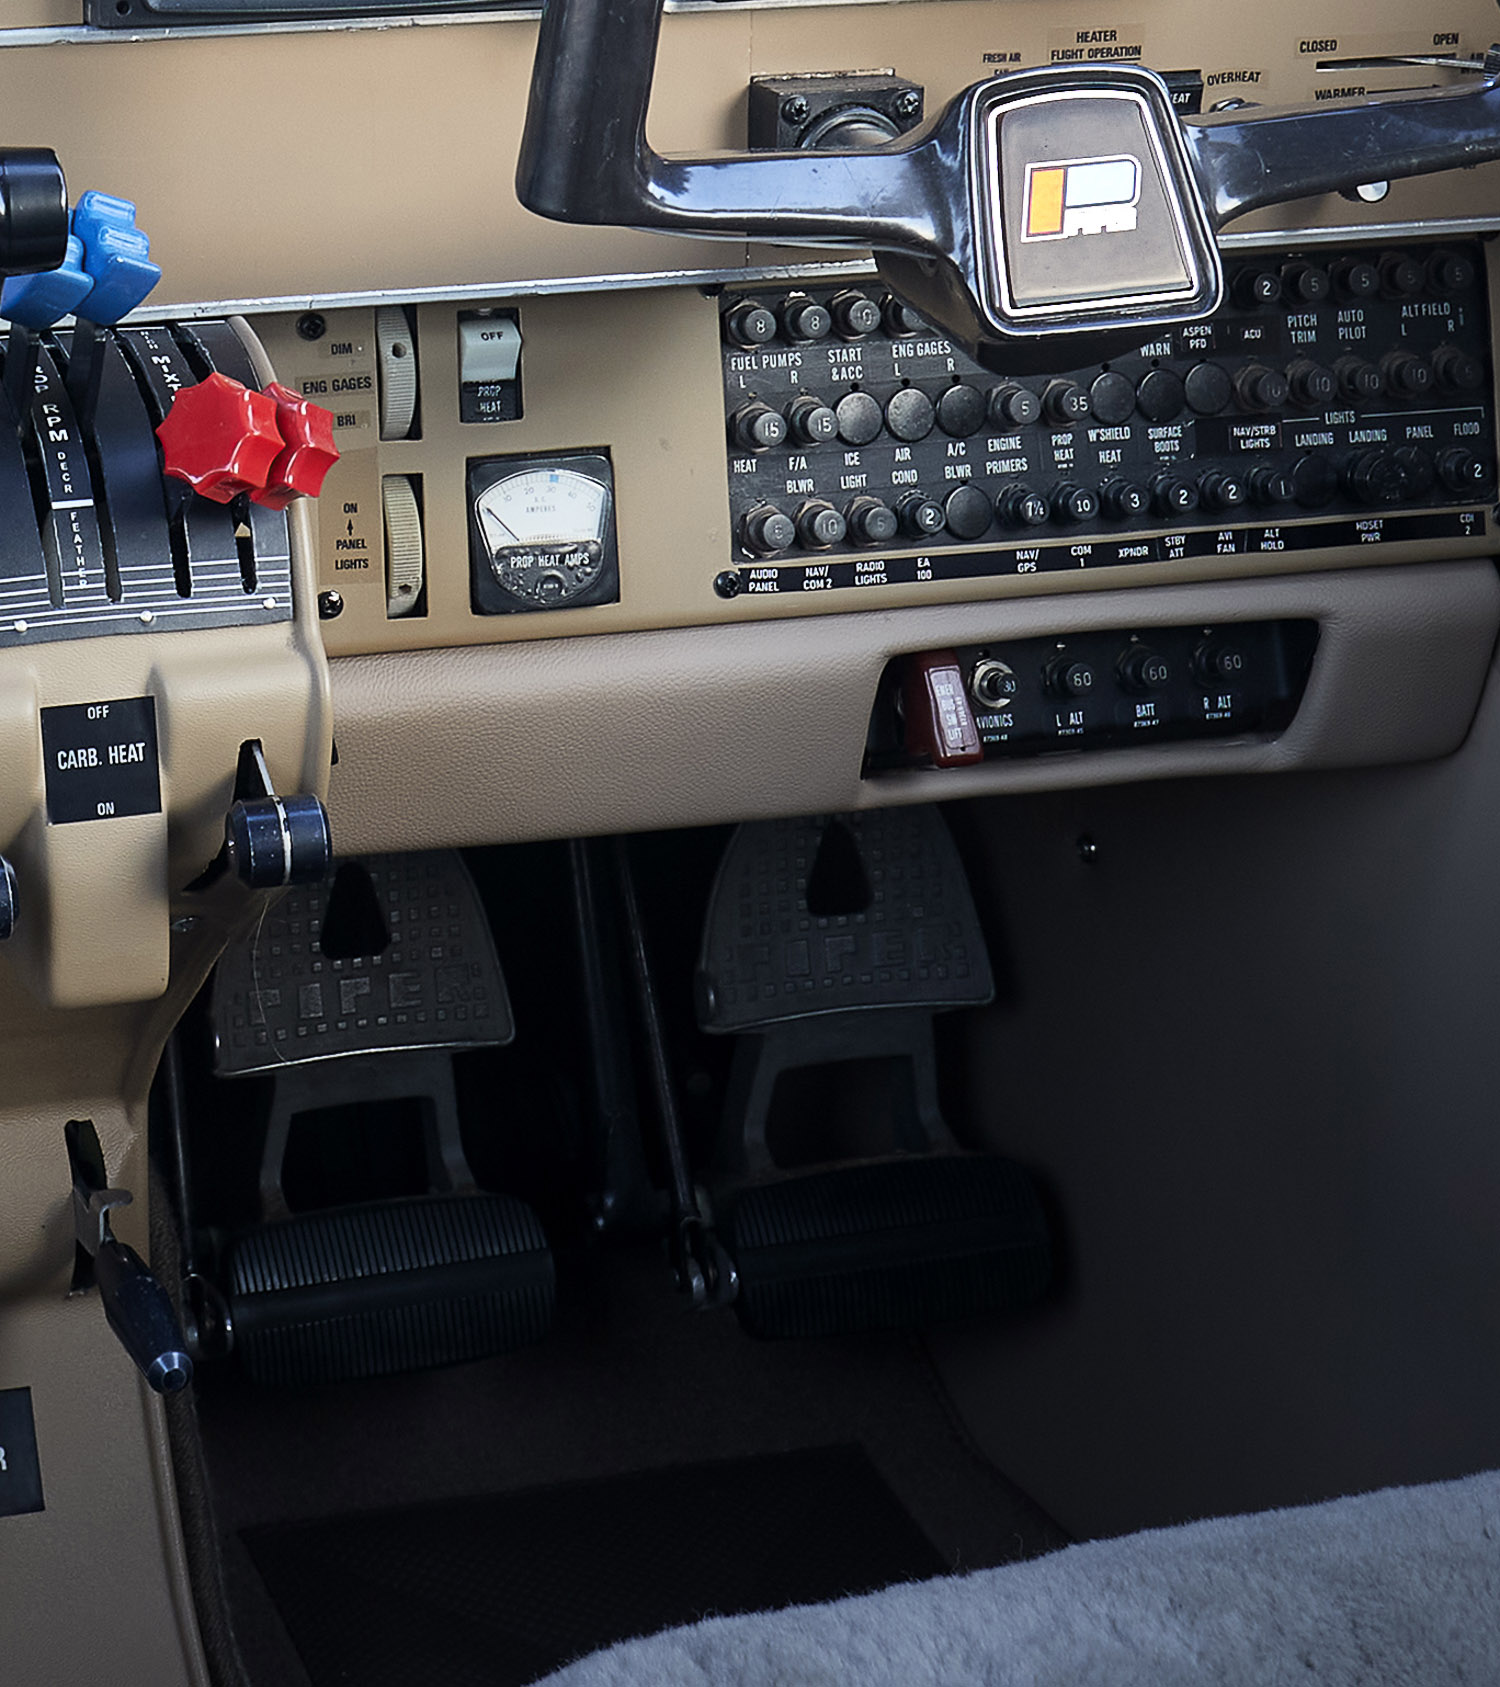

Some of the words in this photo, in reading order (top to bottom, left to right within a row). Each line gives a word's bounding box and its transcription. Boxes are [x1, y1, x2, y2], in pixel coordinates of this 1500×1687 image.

[1076, 29, 1117, 44] HEATER
[1050, 46, 1091, 60] FLIGHT
[1095, 43, 1142, 60] OPERATION
[1299, 38, 1337, 54] CLOSED
[1207, 71, 1260, 86] OVERHEAT
[731, 356, 757, 370] FUEL
[762, 354, 802, 367] PUMPS
[303, 380, 327, 394] ENG
[332, 377, 372, 391] GAGES
[1148, 427, 1182, 439] SURFACE
[988, 437, 1021, 451] ENGINE
[986, 458, 1028, 474] PRIMERS
[336, 539, 367, 550] PANEL
[1118, 547, 1148, 558] XPNDR
[335, 558, 368, 570] LIGHTS
[510, 556, 533, 569] PROP
[538, 554, 560, 567] HEAT
[564, 553, 590, 566] AMPS
[750, 569, 778, 580] AUDIO
[87, 705, 109, 719] OFF
[57, 747, 103, 770] CARB.
[108, 742, 145, 764] HEAT
